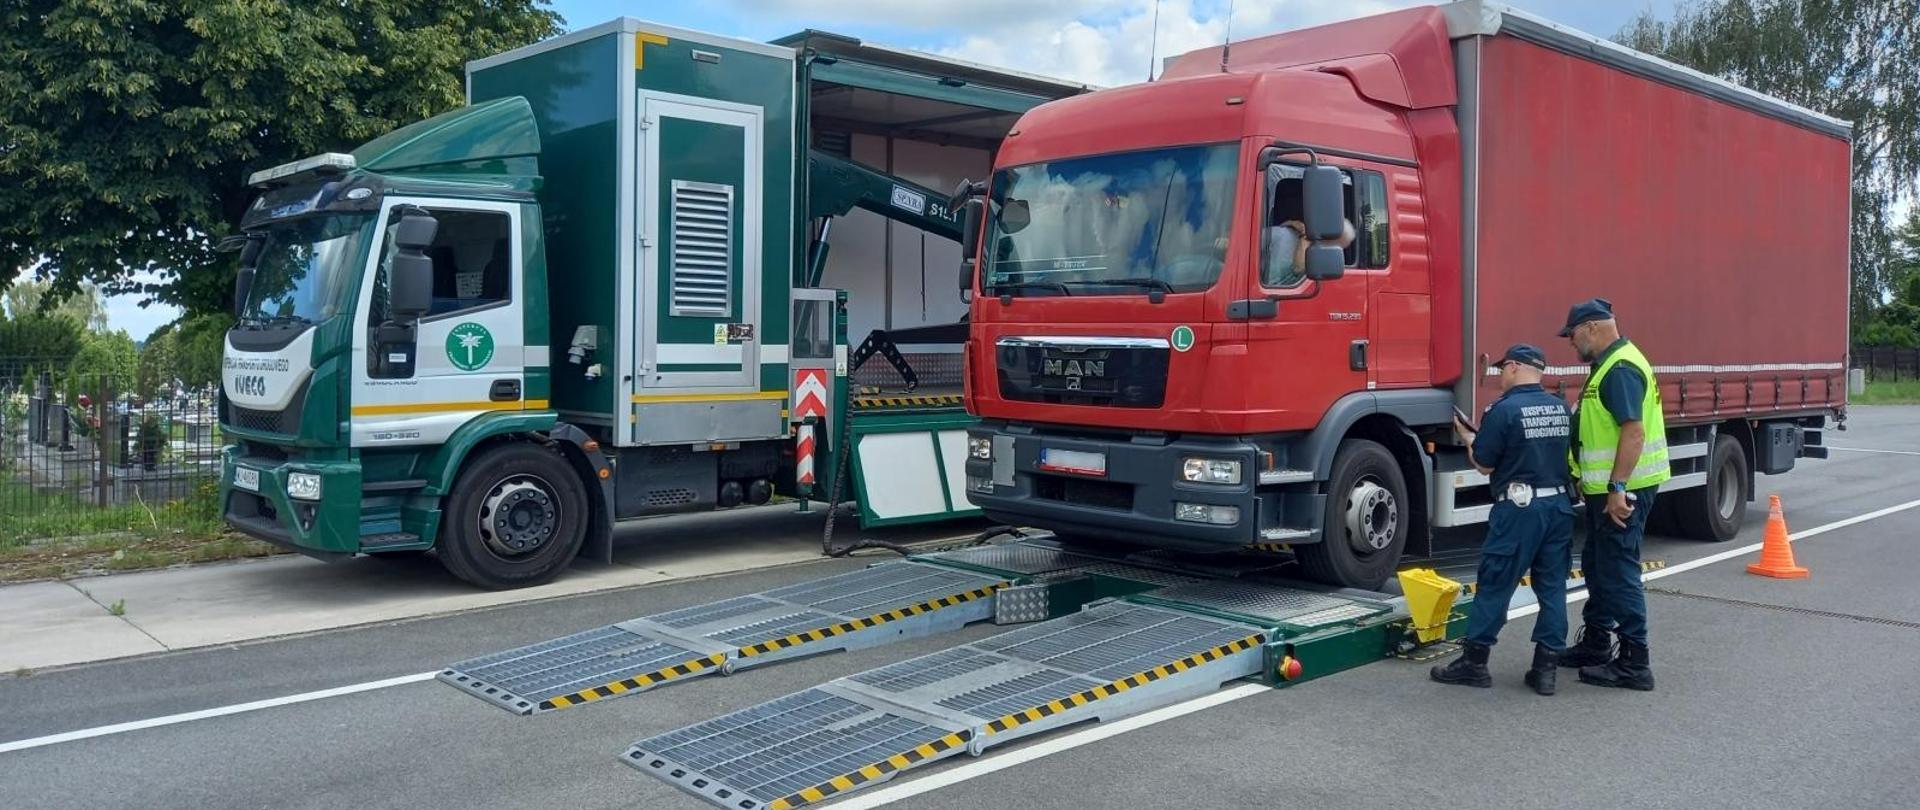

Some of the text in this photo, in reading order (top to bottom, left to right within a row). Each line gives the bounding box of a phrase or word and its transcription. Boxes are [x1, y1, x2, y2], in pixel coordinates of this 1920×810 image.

[1177, 330, 1188, 347] L
[1044, 359, 1104, 377] MAN
[234, 375, 265, 397] IVECO
[1521, 404, 1566, 417] INSPEKCJA
[1520, 415, 1570, 428] TRANSPORTU
[1525, 426, 1569, 439] DROGOWEGO
